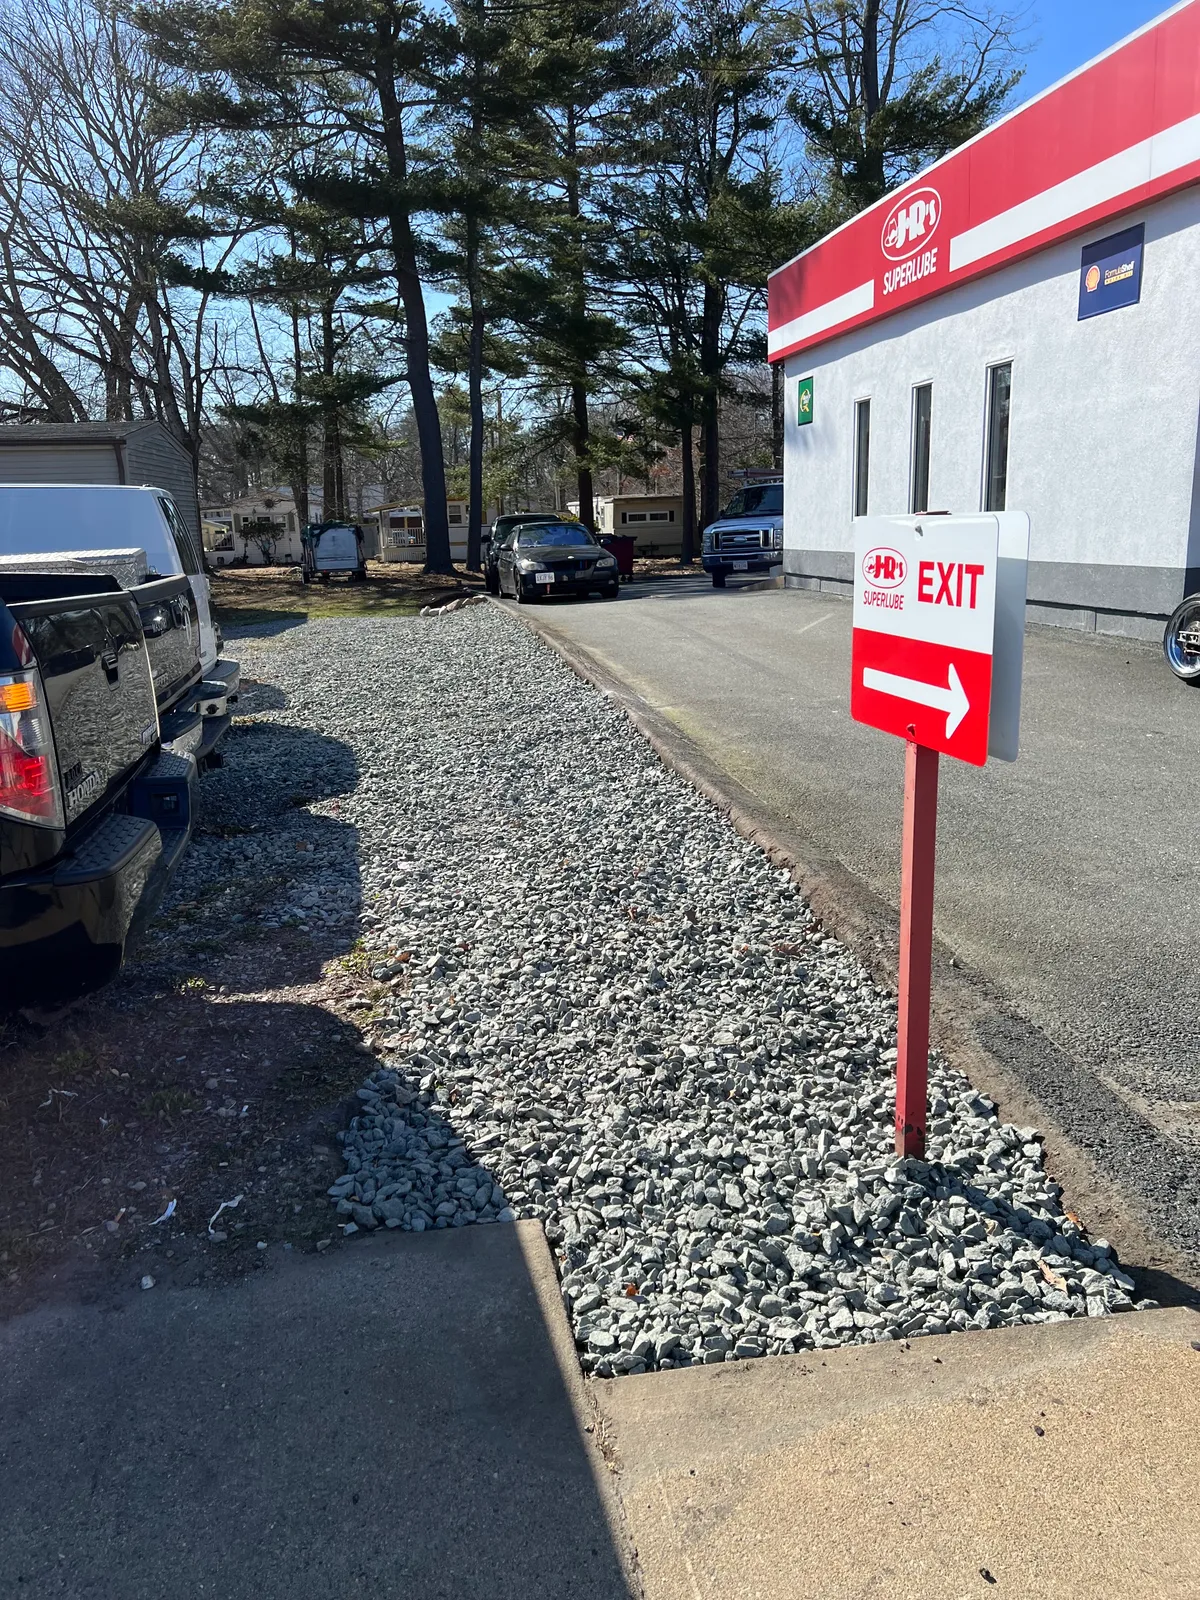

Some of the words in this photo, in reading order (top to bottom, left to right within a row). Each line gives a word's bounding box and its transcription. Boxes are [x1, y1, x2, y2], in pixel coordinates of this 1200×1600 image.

[882, 247, 938, 296] SUPERLUBE
[863, 590, 905, 611] SUPERLUBE
[917, 560, 985, 609] EXIT
[67, 770, 102, 810] HONDA
